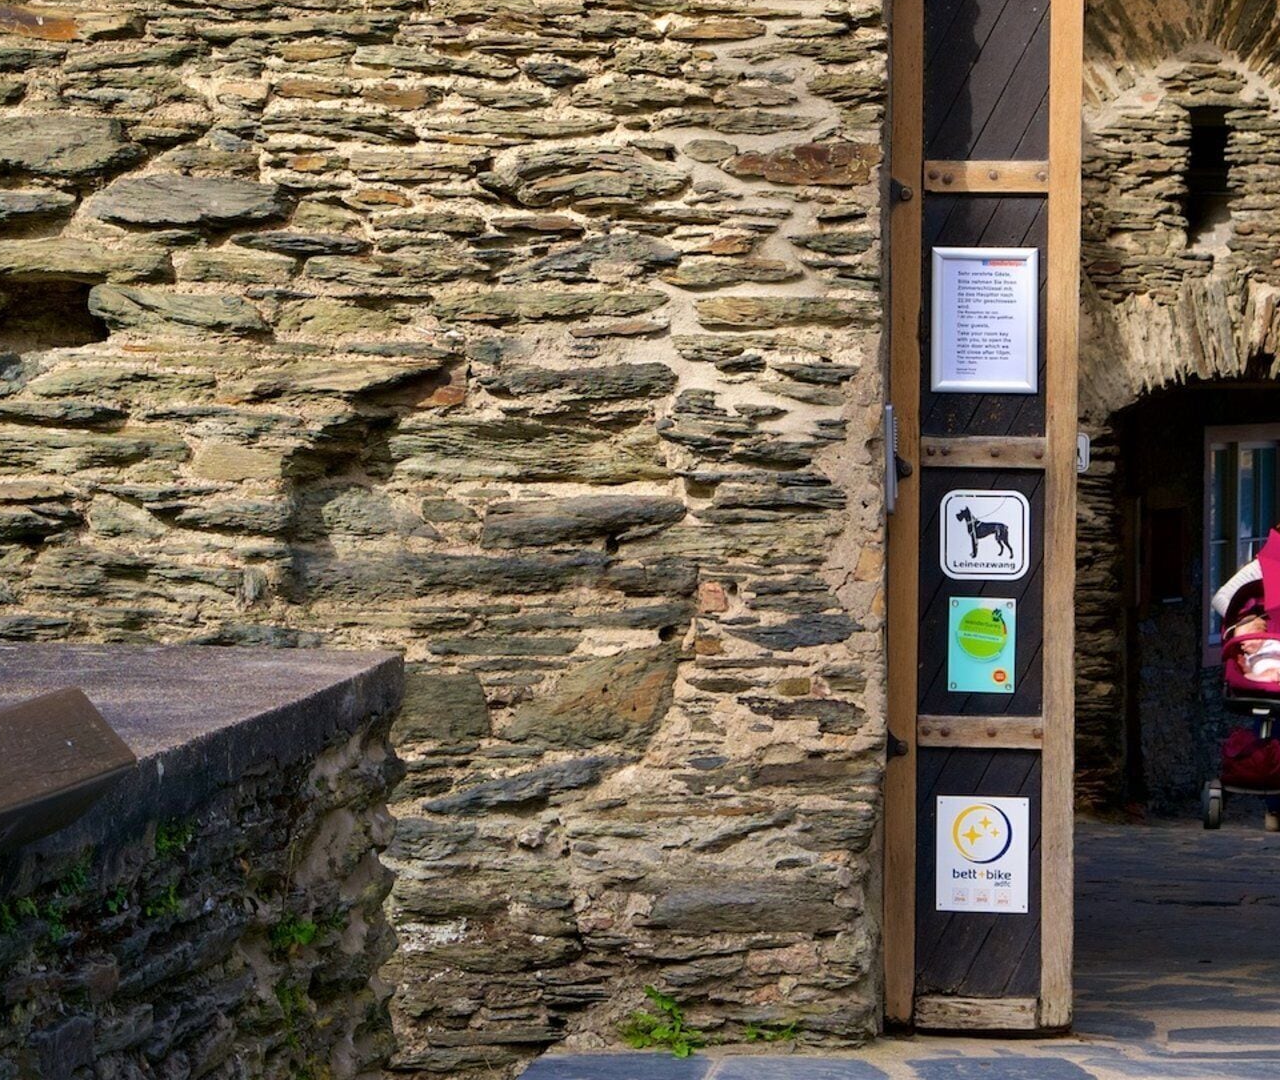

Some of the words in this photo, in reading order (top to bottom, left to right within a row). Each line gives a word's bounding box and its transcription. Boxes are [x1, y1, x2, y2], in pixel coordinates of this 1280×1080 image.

[953, 560, 1016, 570] Leinenzwang
[952, 868, 977, 879] bett
[986, 869, 1012, 881] bike
